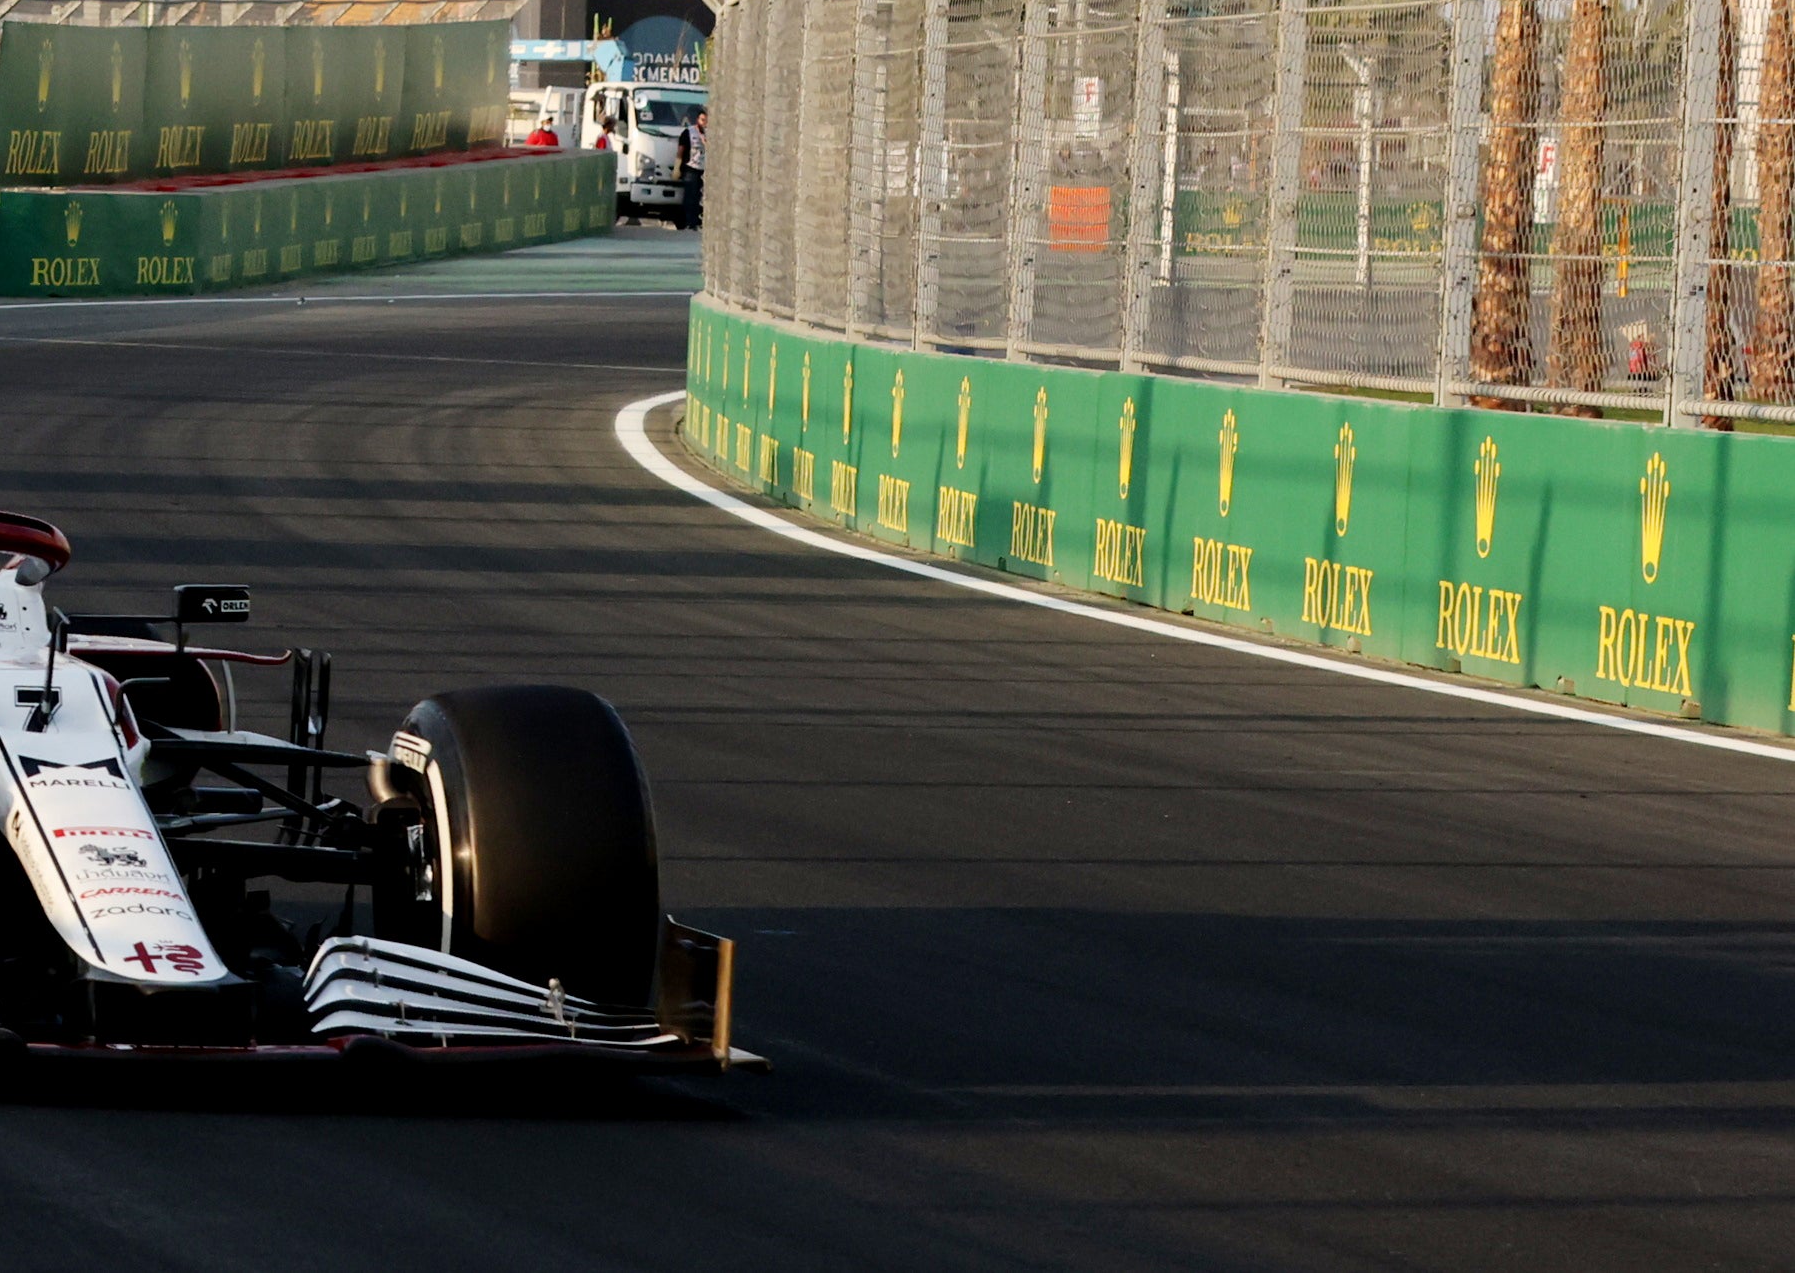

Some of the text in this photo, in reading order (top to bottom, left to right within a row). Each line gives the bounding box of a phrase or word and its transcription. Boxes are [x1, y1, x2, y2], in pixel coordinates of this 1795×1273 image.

[5, 130, 61, 174] ROLEX
[30, 258, 98, 286] ROLEX
[137, 256, 194, 285] ROLEX
[877, 474, 910, 533] ROLEX
[936, 486, 977, 548] ROLEX
[1010, 500, 1056, 567] ROLEX
[1094, 518, 1146, 588] ROLEX
[1190, 537, 1252, 612] ROLEX
[1302, 557, 1373, 636] ROLEX
[1435, 580, 1523, 665] ROLEX
[1596, 605, 1695, 697] ROLEX
[14, 685, 62, 733] 7
[29, 777, 132, 791] MARELLI
[80, 887, 185, 902] CARRERA
[91, 903, 194, 922] zadara
